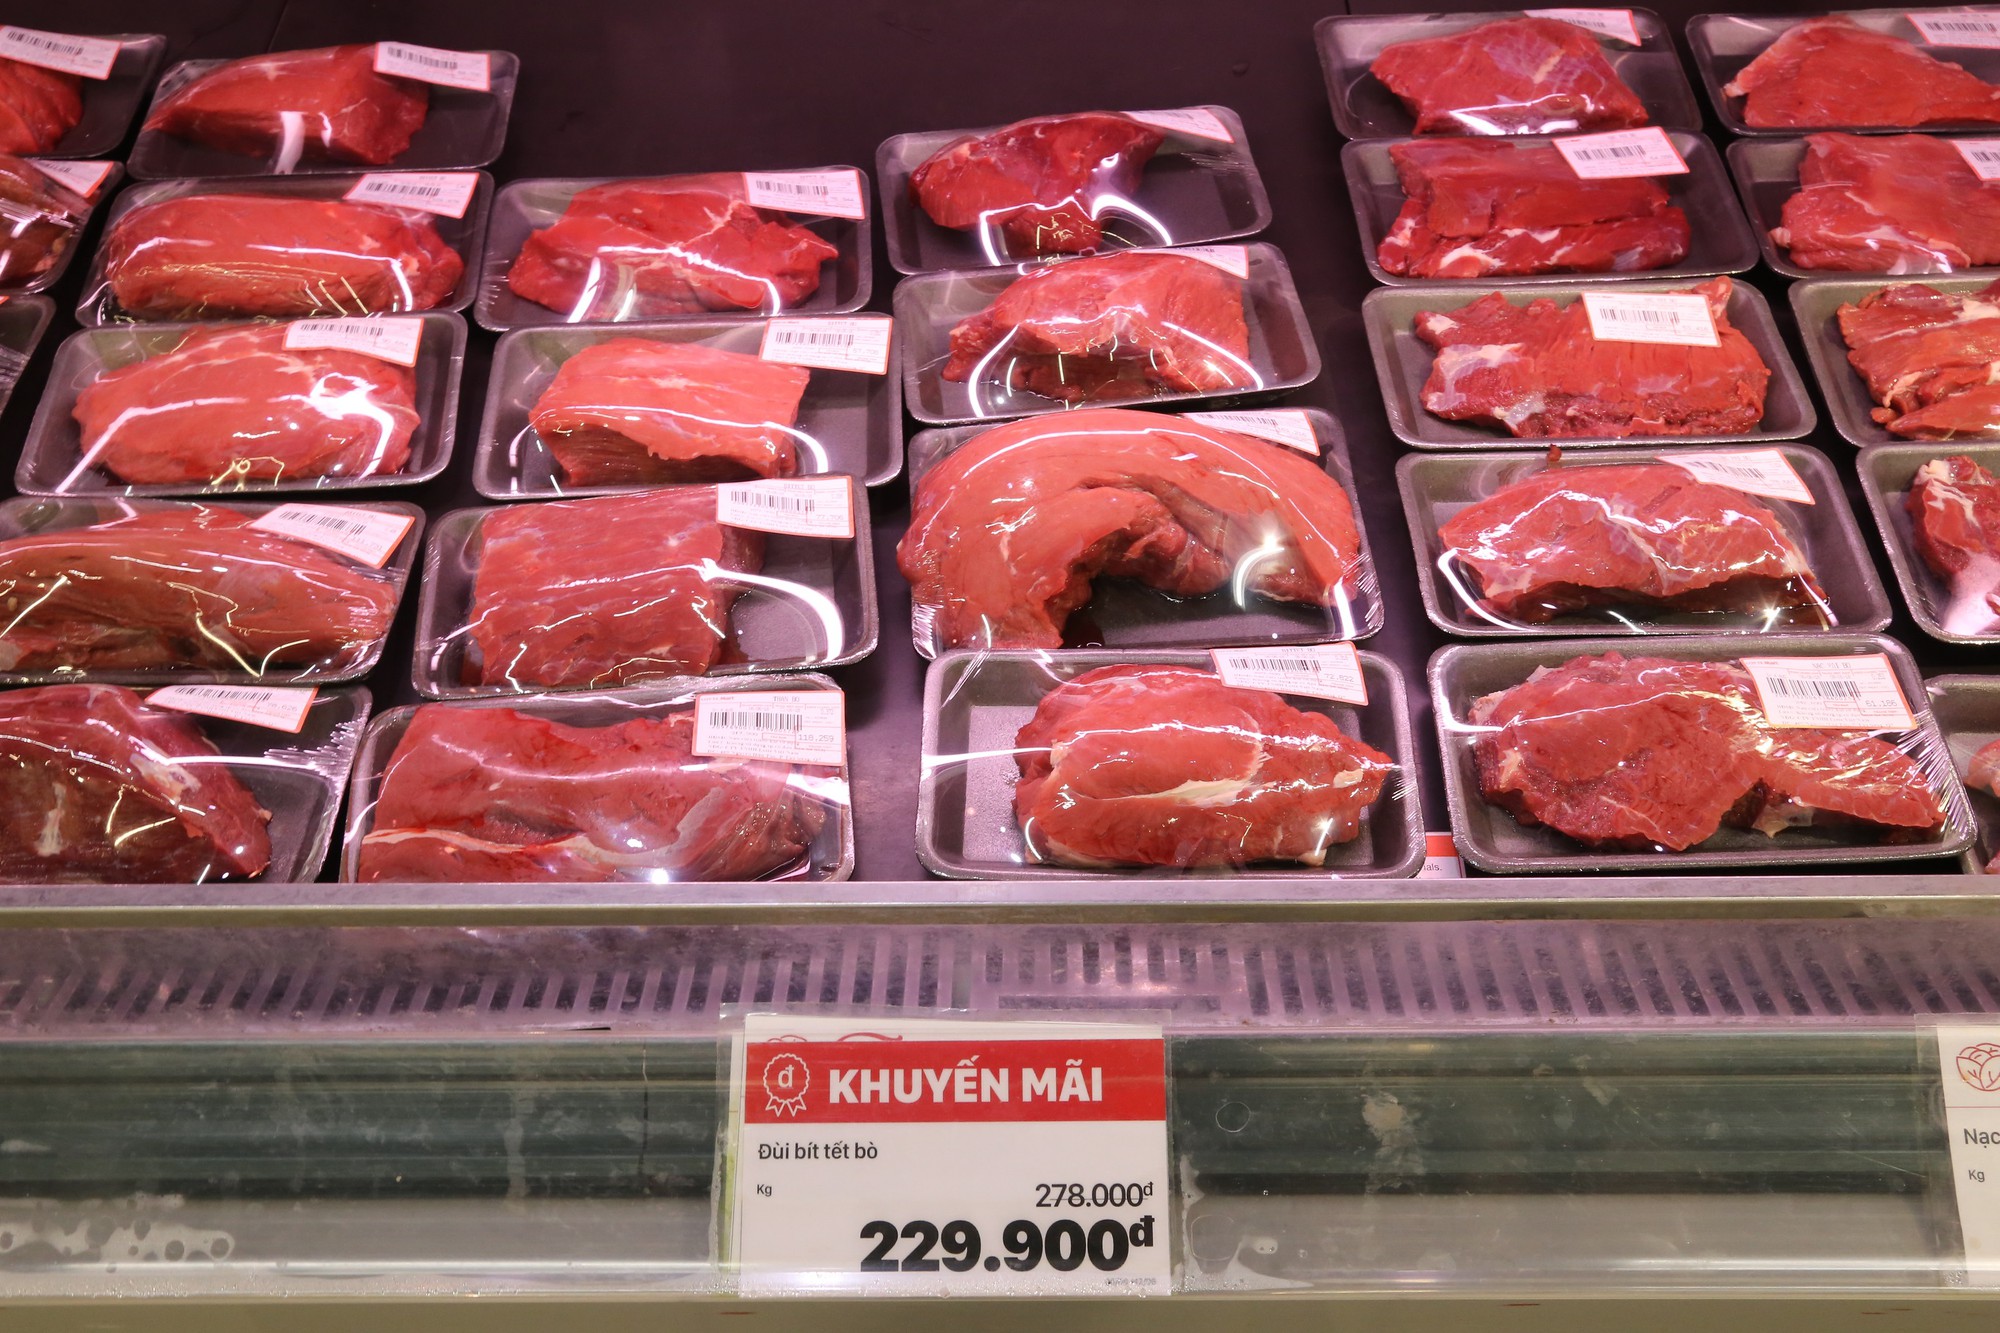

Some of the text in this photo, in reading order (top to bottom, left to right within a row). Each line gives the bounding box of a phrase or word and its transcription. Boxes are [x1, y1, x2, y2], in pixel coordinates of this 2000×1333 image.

[829, 1055, 1103, 1104] KHUYẾN MÃI
[1963, 1128, 2000, 1149] Nạc
[758, 1141, 879, 1160] Đùi bít tết bò
[1968, 1169, 1986, 1183] Kg
[756, 1184, 773, 1197] Kg
[860, 1215, 1155, 1272] 229.900đ
